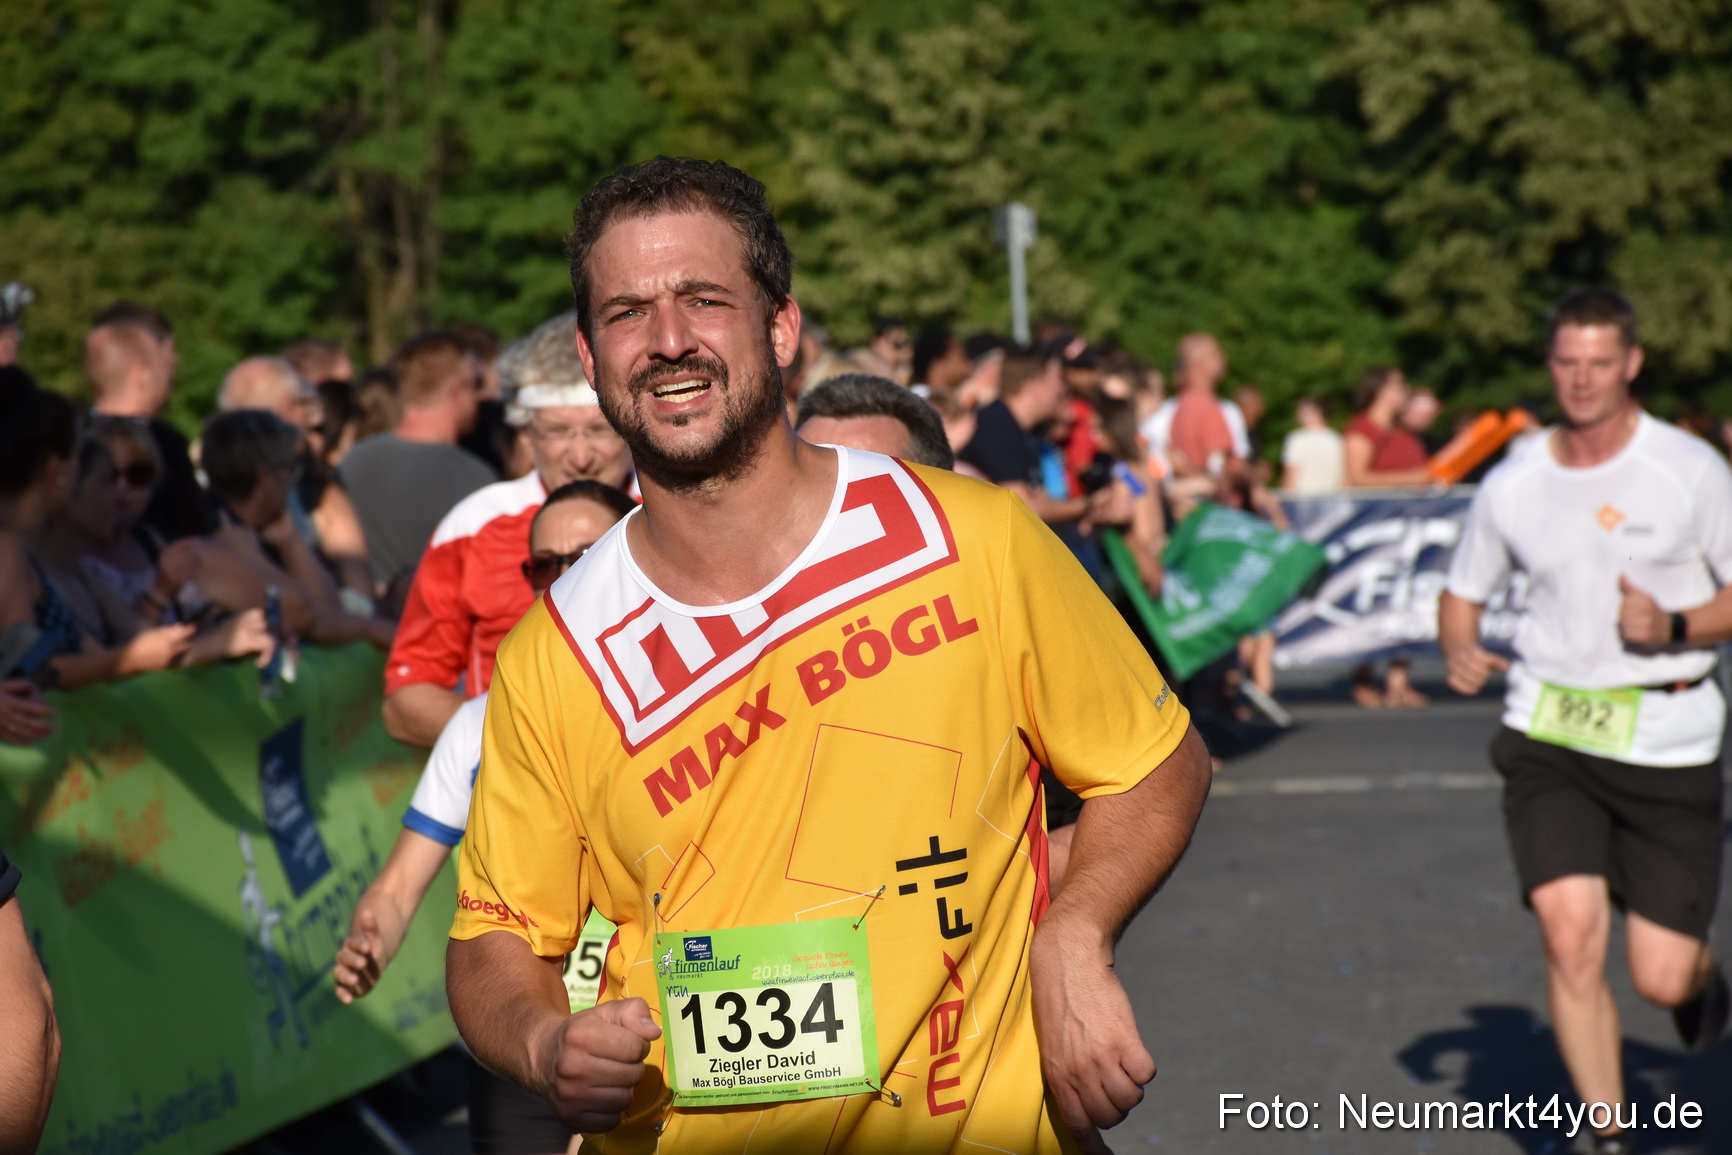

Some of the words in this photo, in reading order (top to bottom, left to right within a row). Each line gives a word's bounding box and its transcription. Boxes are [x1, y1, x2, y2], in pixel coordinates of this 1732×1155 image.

[643, 682, 787, 818] MAX
[796, 594, 980, 707] BÖGL
[1558, 693, 1614, 733] 992
[675, 954, 741, 974] firmenlauf
[751, 964, 792, 980] 2018
[681, 982, 844, 1055] 1334
[709, 1056, 762, 1076] Ziegler
[767, 1050, 816, 1069] David
[692, 1077, 711, 1088] Max
[713, 1075, 736, 1089] Bögl
[739, 1071, 801, 1086] Bauservice
[804, 1066, 842, 1080] GmbH
